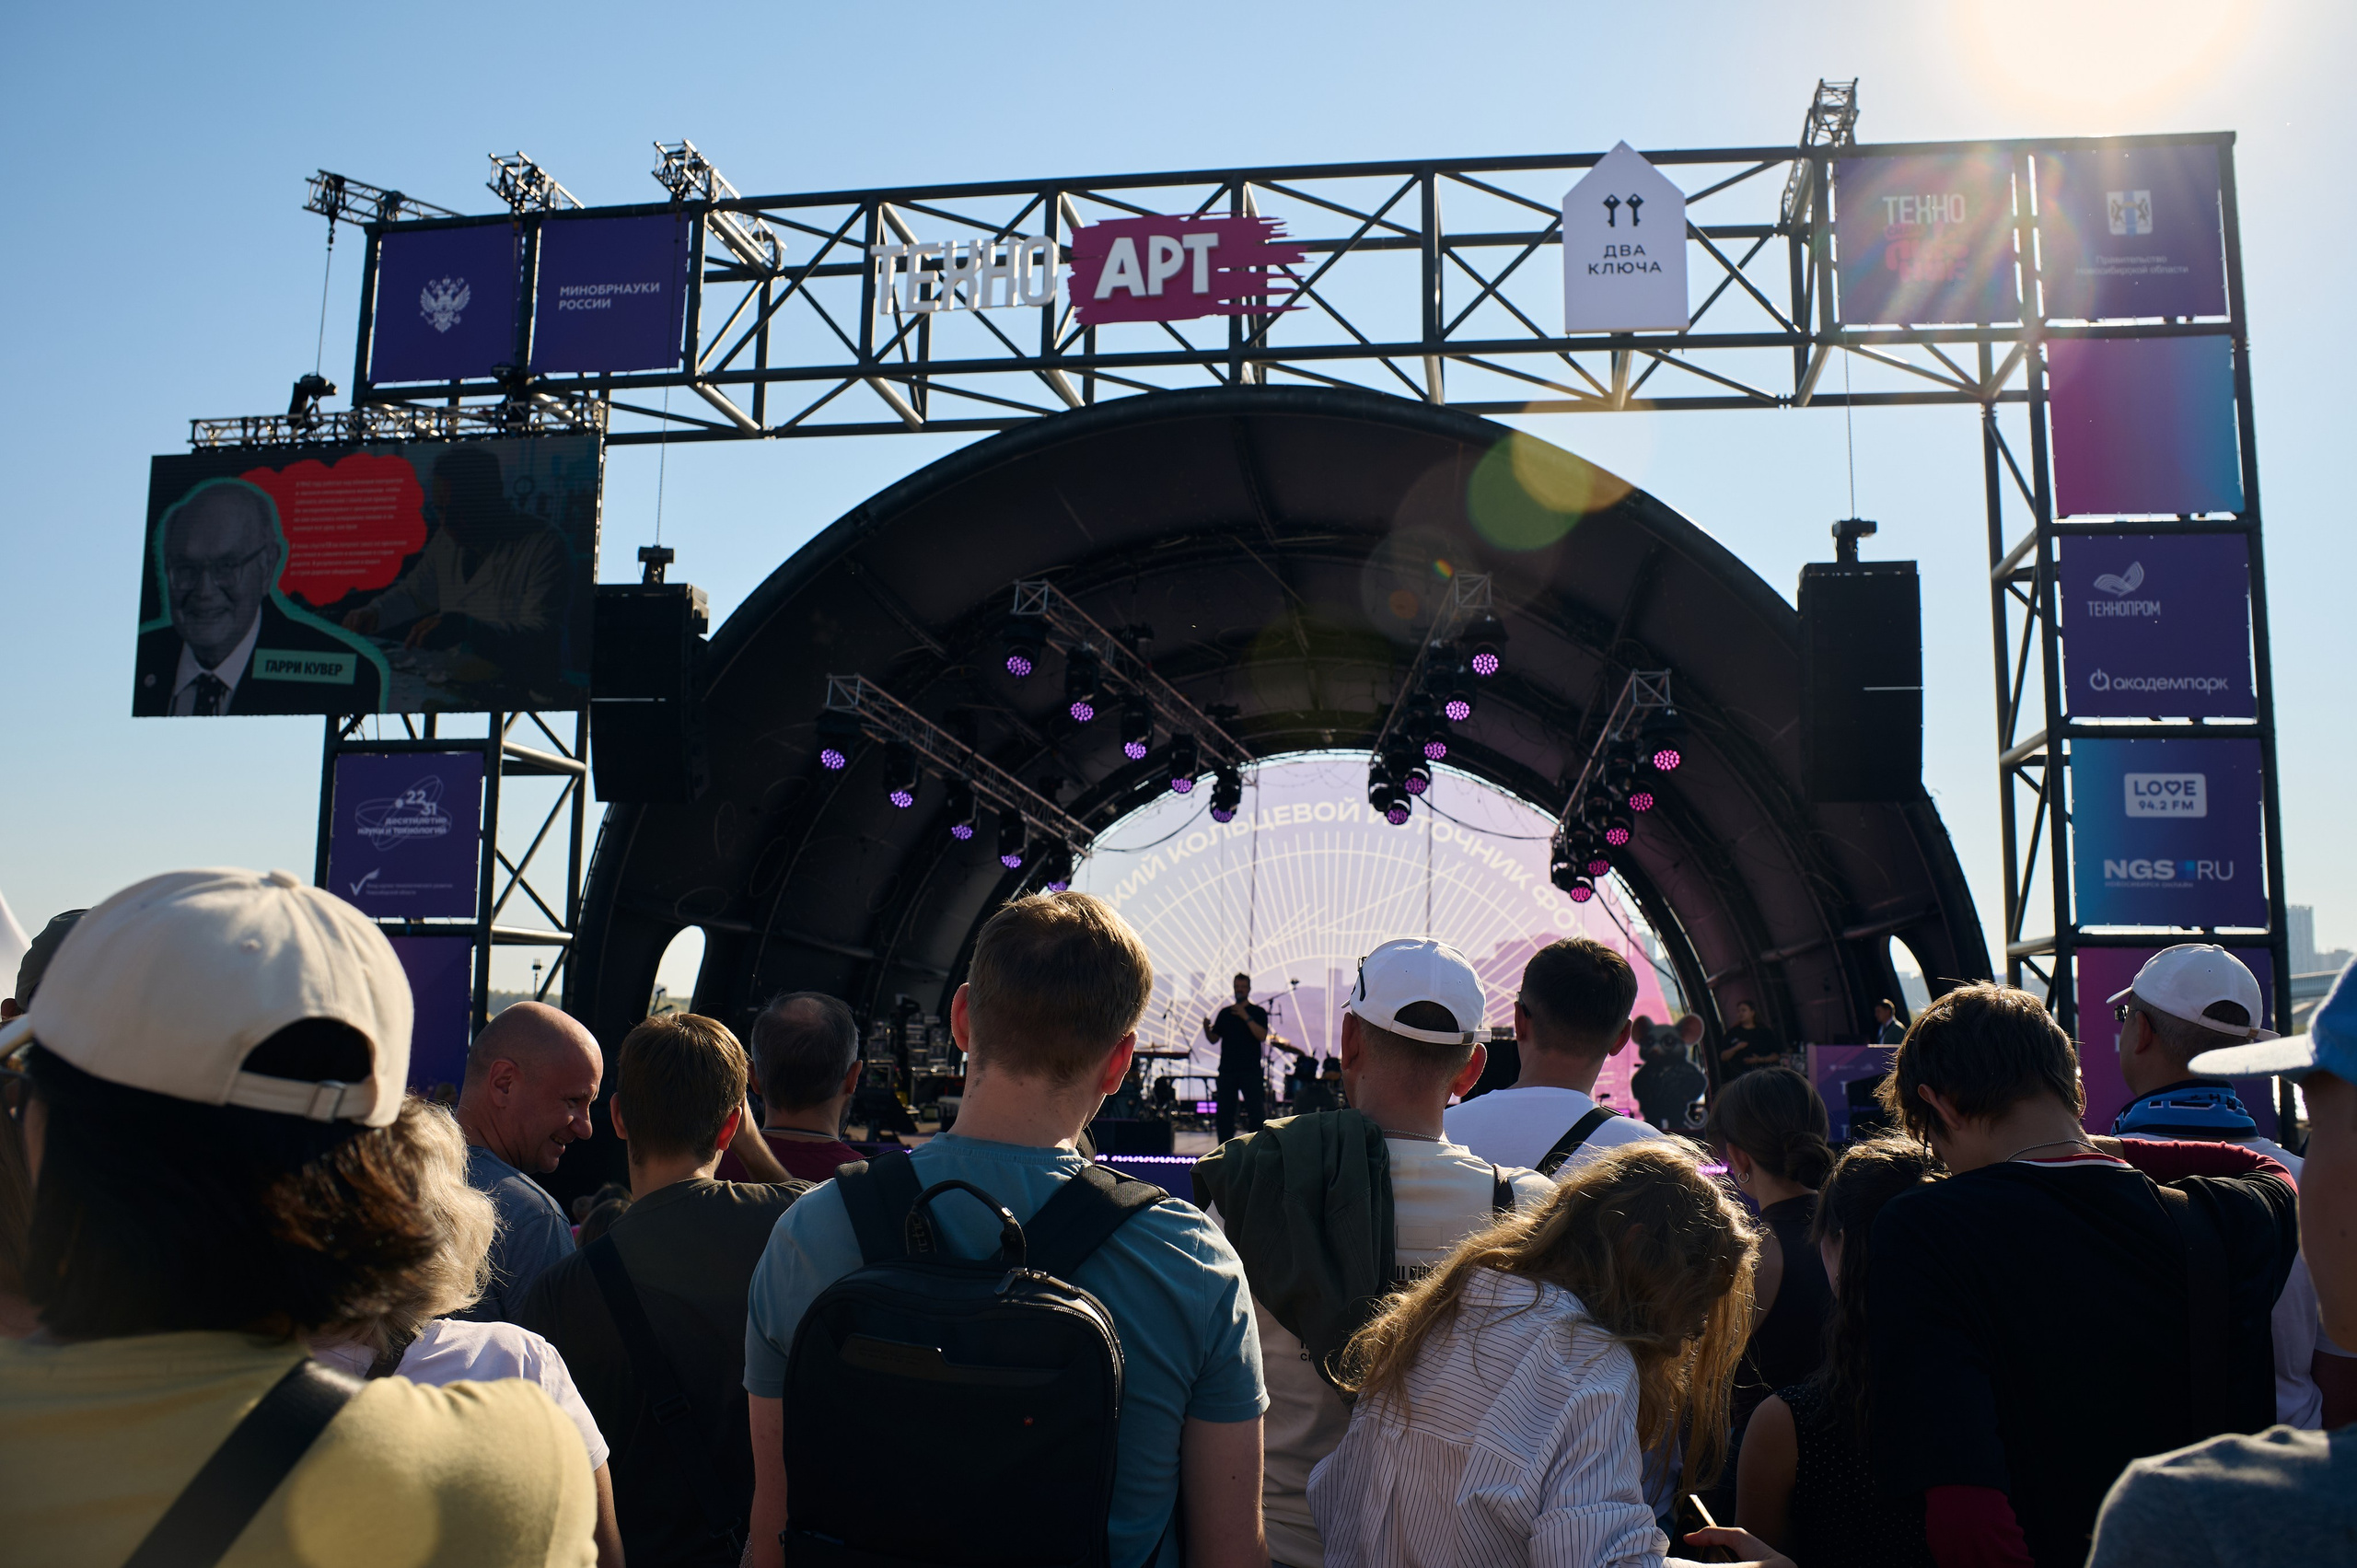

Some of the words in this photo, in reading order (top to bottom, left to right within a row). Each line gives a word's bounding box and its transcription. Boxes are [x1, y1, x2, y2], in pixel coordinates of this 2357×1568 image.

[1883, 194, 1965, 225] ТЕХНО
[1603, 244, 1646, 259] ДВА
[870, 236, 1058, 315] ТЕХНО
[1093, 232, 1219, 300] АРТ
[1588, 261, 1662, 275] КЛЮЧА
[560, 282, 660, 296] МИНОБРНАУКИ
[559, 298, 611, 310] РОССИИ
[2086, 600, 2161, 617] ТЕХНОПРОМ
[265, 659, 302, 674] ГАРРИ
[304, 661, 343, 677] КУВЕР
[2113, 677, 2229, 694] академпарк
[406, 790, 426, 805] 22
[2139, 800, 2167, 810] 94.2
[2172, 799, 2195, 810] FM
[421, 803, 437, 816] 31
[1167, 797, 1360, 865] КОЛЬЦЕВОЙ
[2104, 859, 2176, 880] NGS
[2197, 860, 2234, 881] RU
[912, 1217, 929, 1253] rctic
